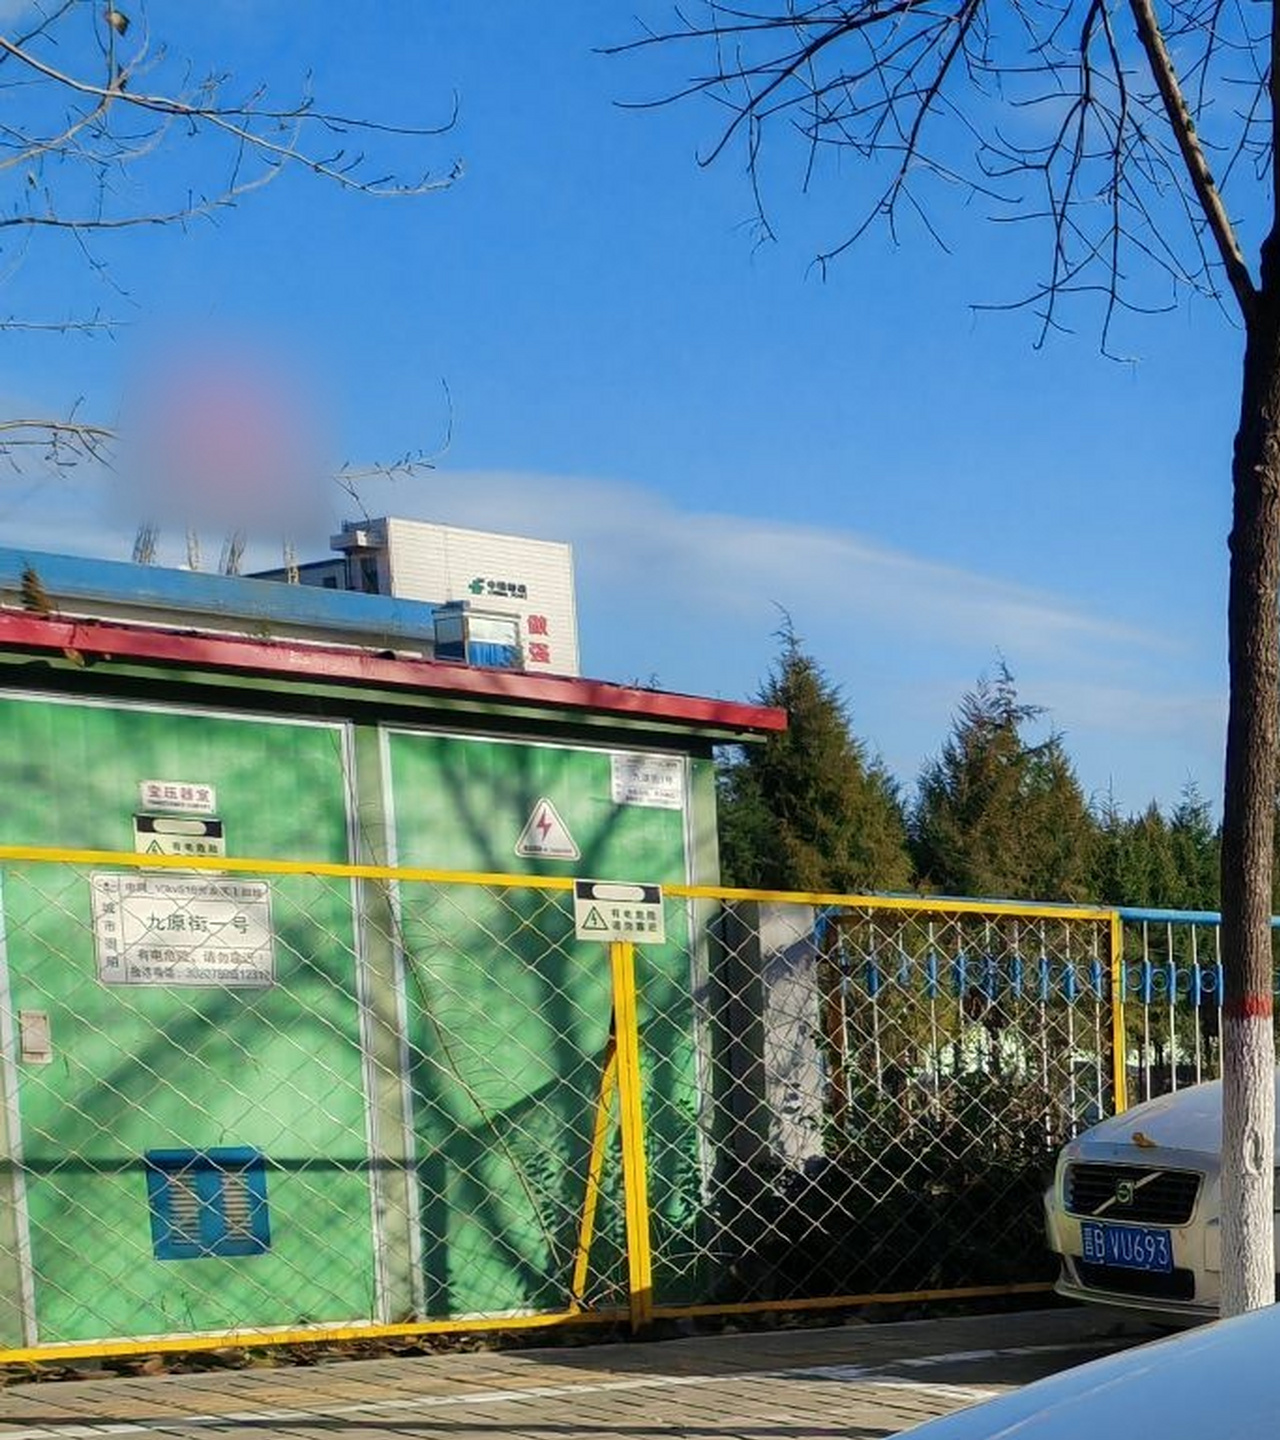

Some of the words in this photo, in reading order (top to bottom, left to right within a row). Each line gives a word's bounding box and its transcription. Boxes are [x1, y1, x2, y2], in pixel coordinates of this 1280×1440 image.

[147, 912, 250, 935] 九原街一号
